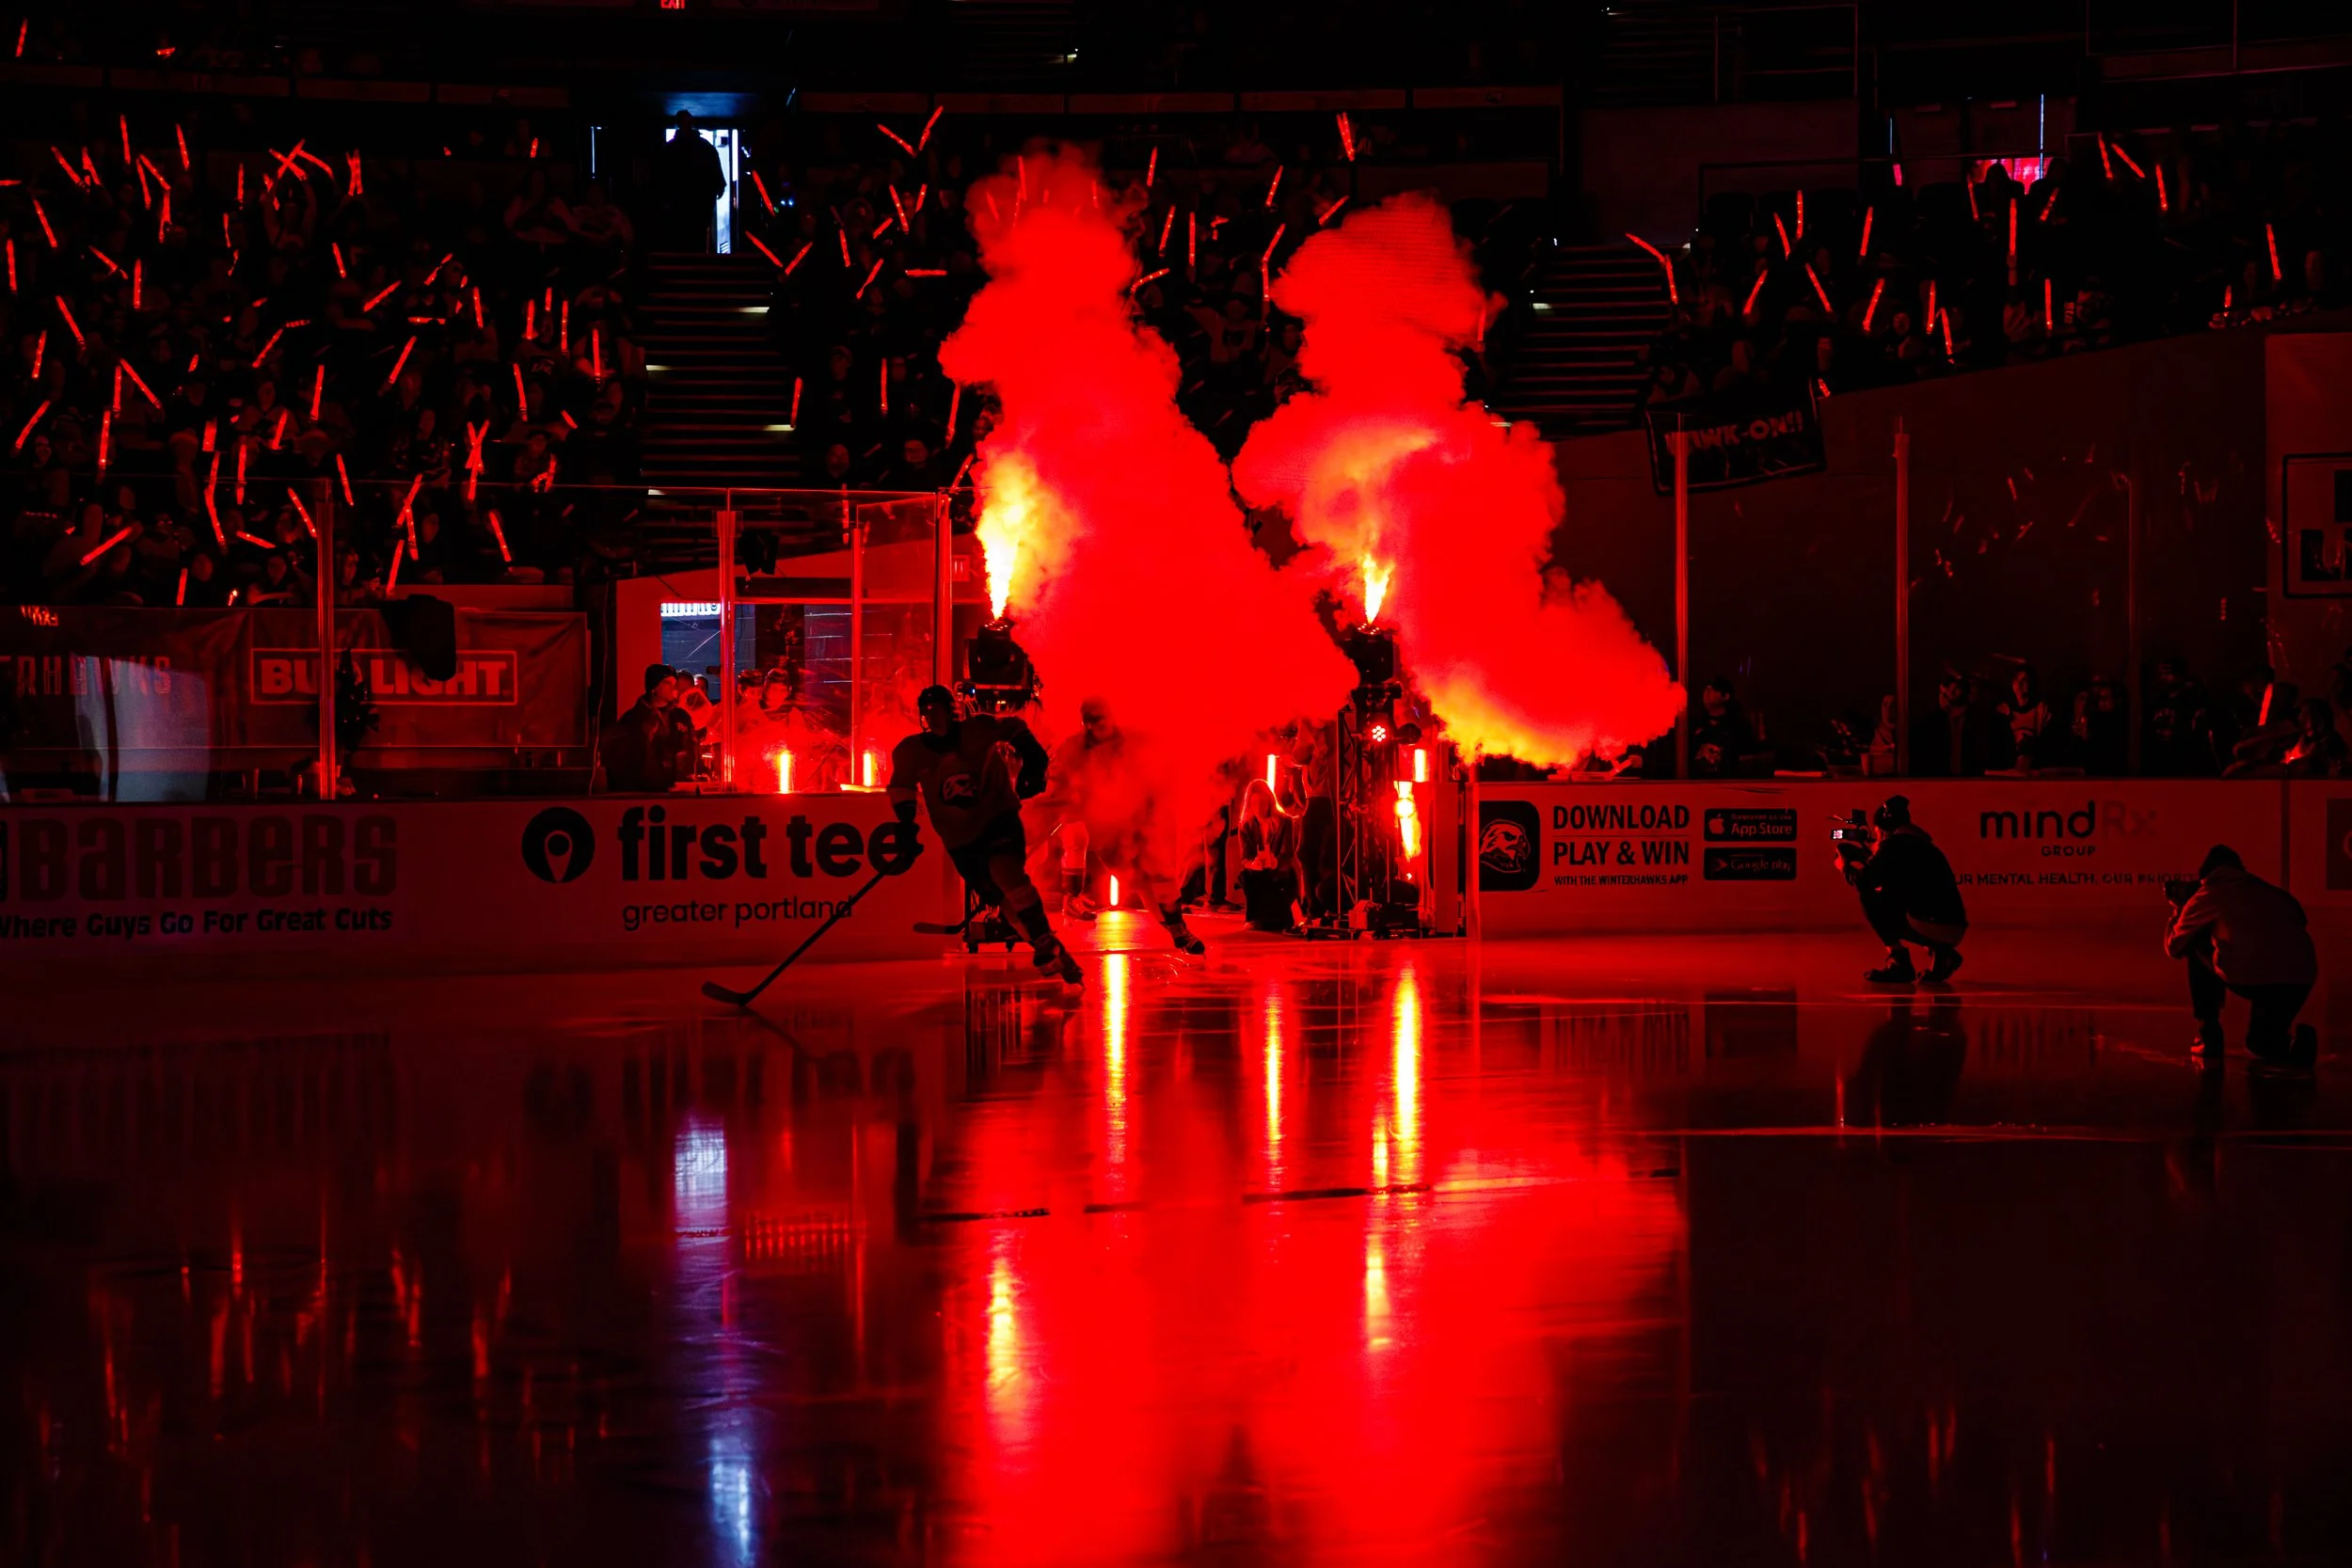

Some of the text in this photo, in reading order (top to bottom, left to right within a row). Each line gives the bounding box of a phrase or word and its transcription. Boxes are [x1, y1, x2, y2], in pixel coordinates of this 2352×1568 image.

[1553, 805, 1690, 830] DOWNLOAD
[1731, 821, 1792, 838] App Store
[617, 805, 921, 881] first tee
[1553, 841, 1690, 865] PLAY & WIN
[2041, 845, 2097, 857] GROUP
[1554, 874, 1689, 886] WITH THE WINTERHAWKS APP
[1977, 873, 2034, 884] MENTAL
[2102, 873, 2133, 884] OUR
[87, 912, 151, 941] Guys
[160, 911, 194, 935] Go
[203, 911, 248, 934] For
[257, 908, 326, 932] Great
[335, 907, 393, 931] Cuts
[622, 895, 852, 931] greater portland
